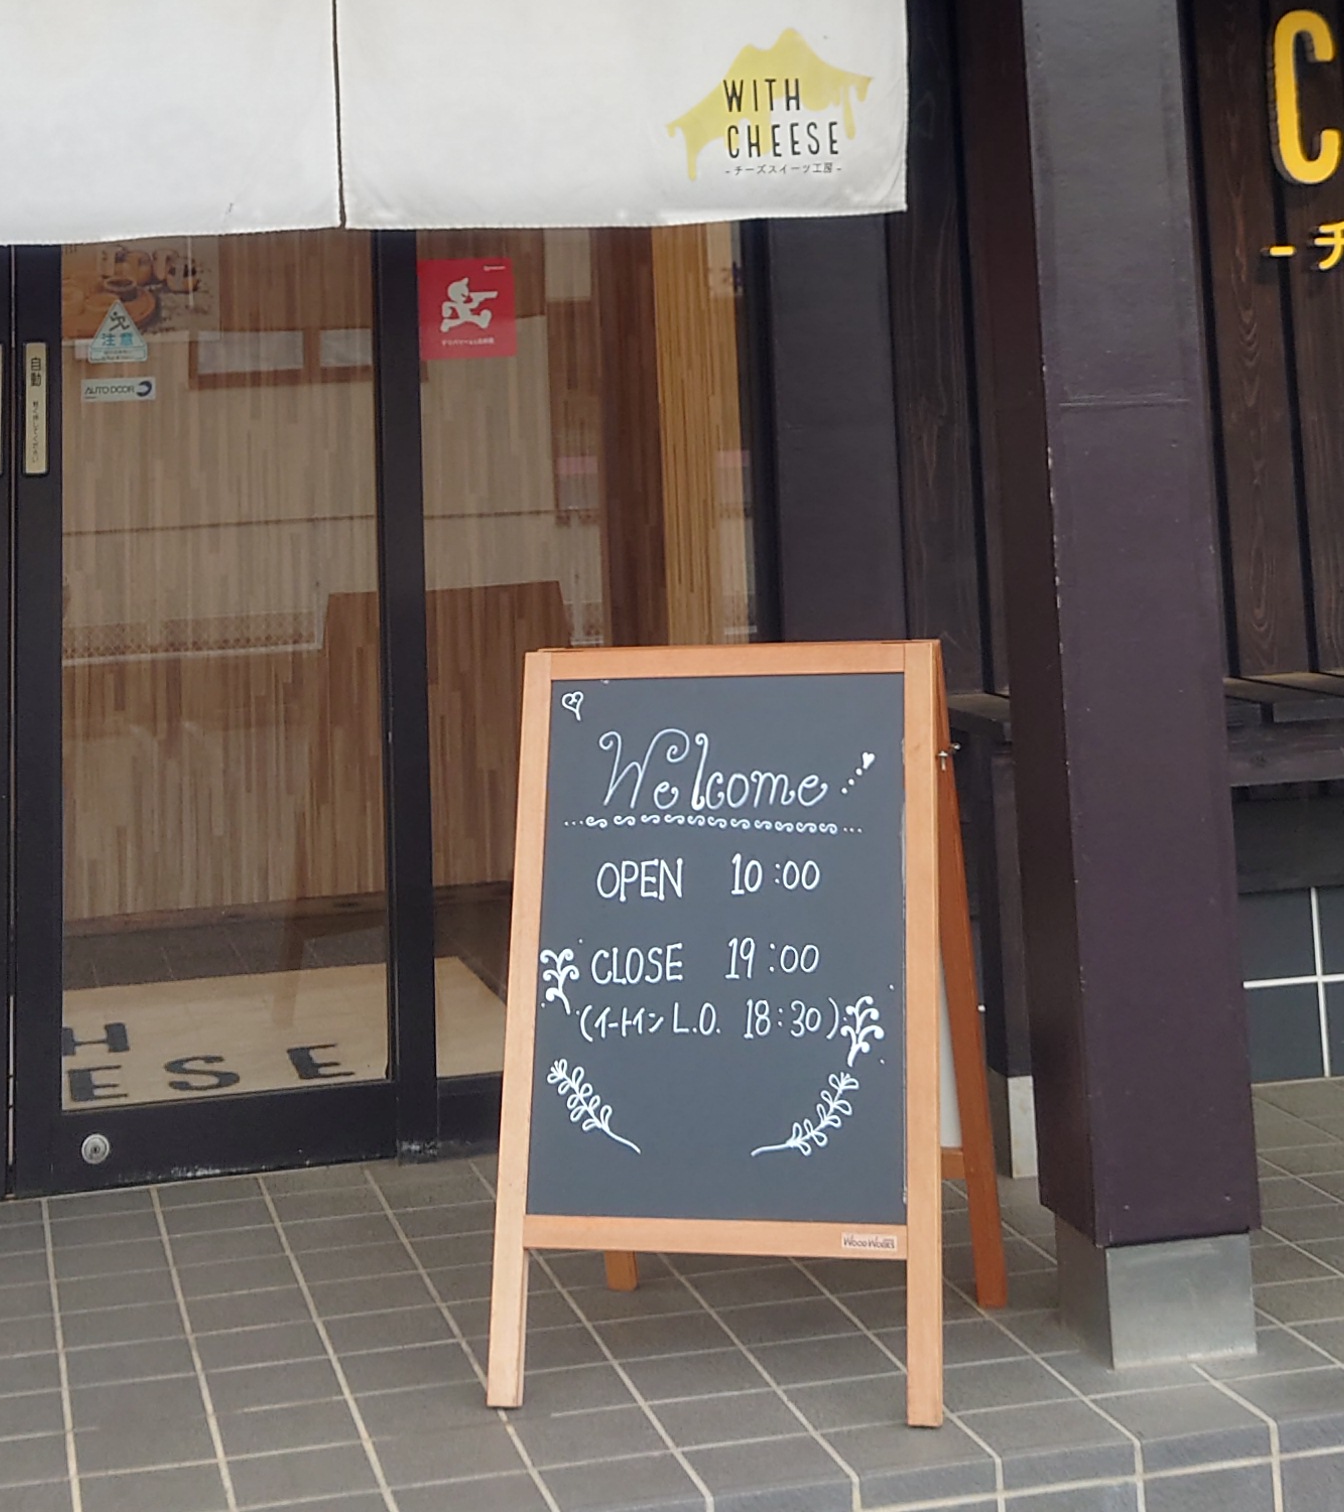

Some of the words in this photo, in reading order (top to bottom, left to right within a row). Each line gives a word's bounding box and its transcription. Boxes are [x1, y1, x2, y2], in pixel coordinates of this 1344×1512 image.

[723, 78, 800, 112] WITH
[727, 121, 839, 158] CHEESE
[102, 332, 134, 347] 注意
[30, 357, 42, 387] 自動
[84, 386, 109, 395] AUTO
[110, 385, 135, 394] DOOR
[599, 728, 828, 811] Welcome
[597, 858, 684, 902] OPEN
[730, 853, 821, 896] 10:00
[591, 942, 684, 986] CLOSE
[725, 938, 820, 979] 19:00
